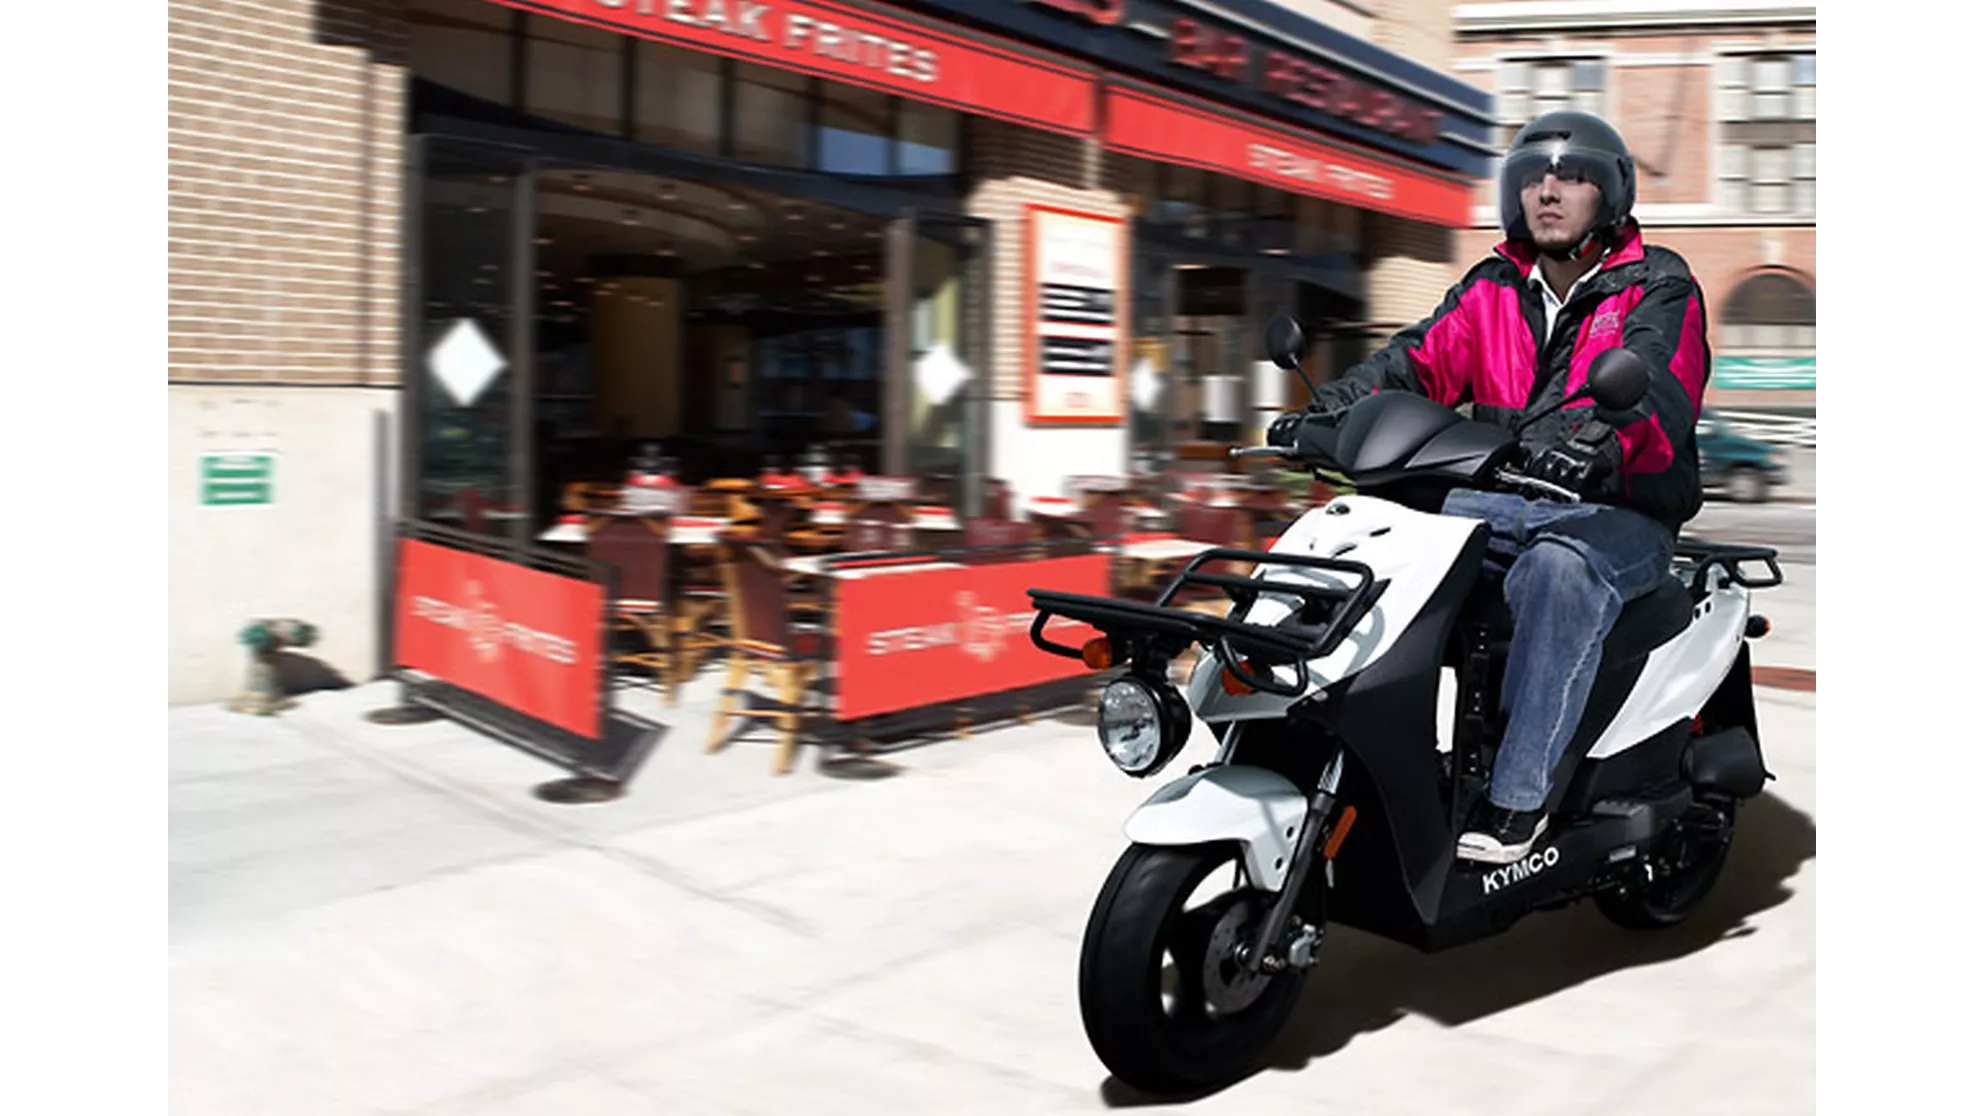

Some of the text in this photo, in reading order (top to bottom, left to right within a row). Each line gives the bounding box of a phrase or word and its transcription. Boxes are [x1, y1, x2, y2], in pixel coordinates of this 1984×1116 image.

[597, 0, 940, 82] EAK FRITES
[1169, 16, 1251, 81] BAR
[1246, 143, 1396, 200] STEAK FRITES
[410, 595, 580, 665] STEAK FRITES
[865, 621, 957, 656] STEAK
[1482, 846, 1560, 895] KYMCO
